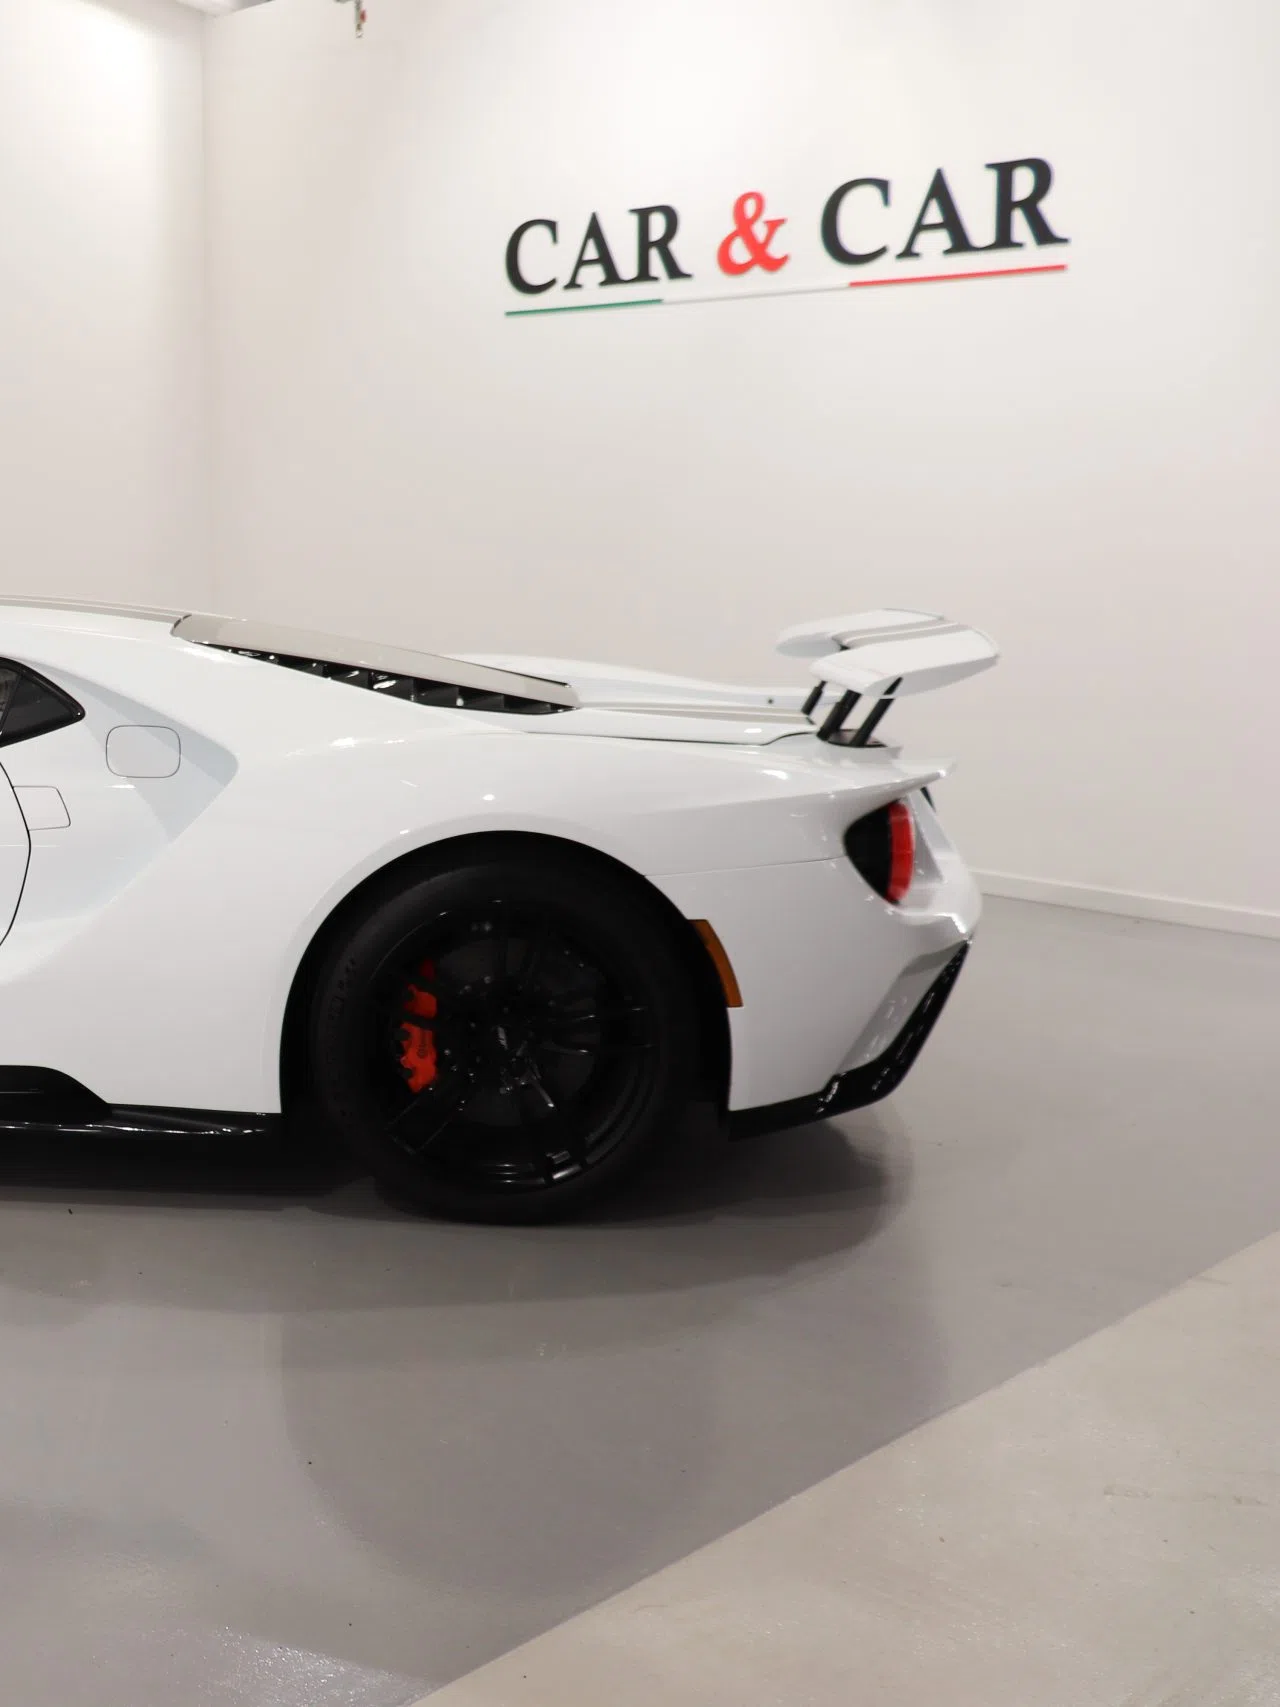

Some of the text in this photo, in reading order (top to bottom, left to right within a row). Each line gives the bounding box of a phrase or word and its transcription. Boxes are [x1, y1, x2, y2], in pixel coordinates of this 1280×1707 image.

[505, 158, 1069, 296] CAR & CAR
